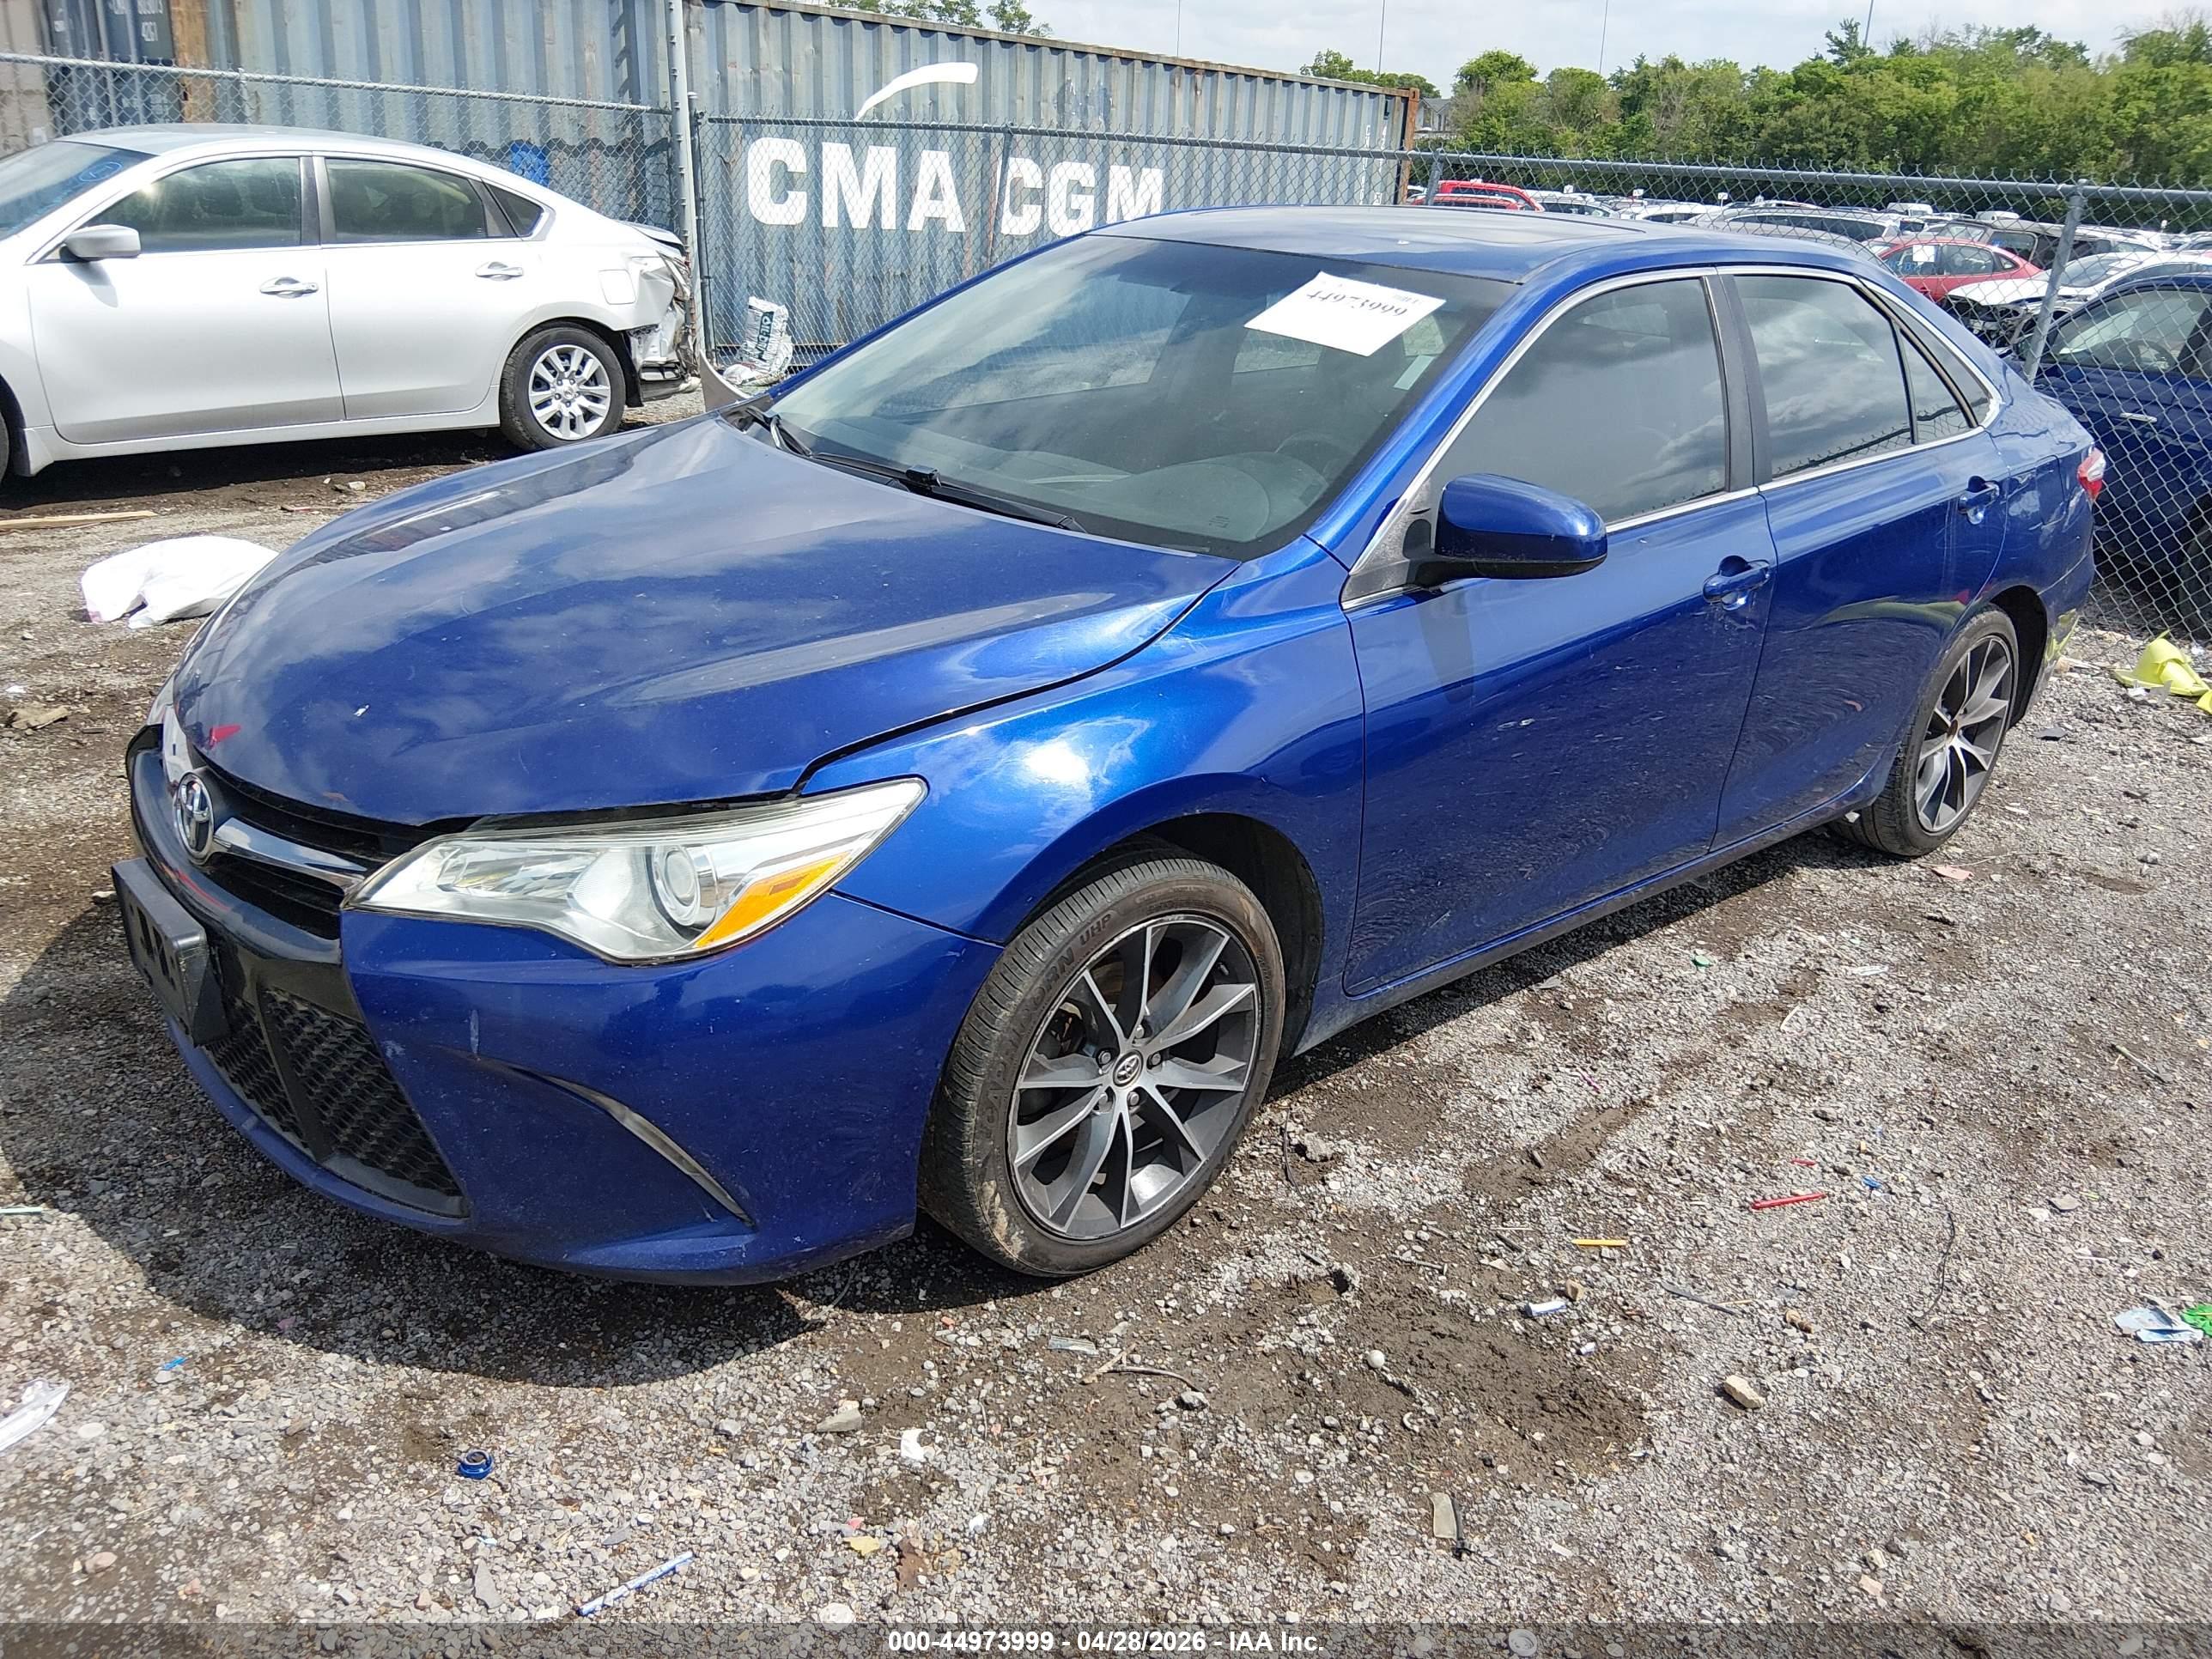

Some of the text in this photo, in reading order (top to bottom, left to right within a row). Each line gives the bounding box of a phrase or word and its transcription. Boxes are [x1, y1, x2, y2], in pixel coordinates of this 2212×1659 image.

[747, 137, 1164, 237] CMA CGM
[1306, 289, 1408, 317] 44973999
[1079, 913, 1112, 946] UHP
